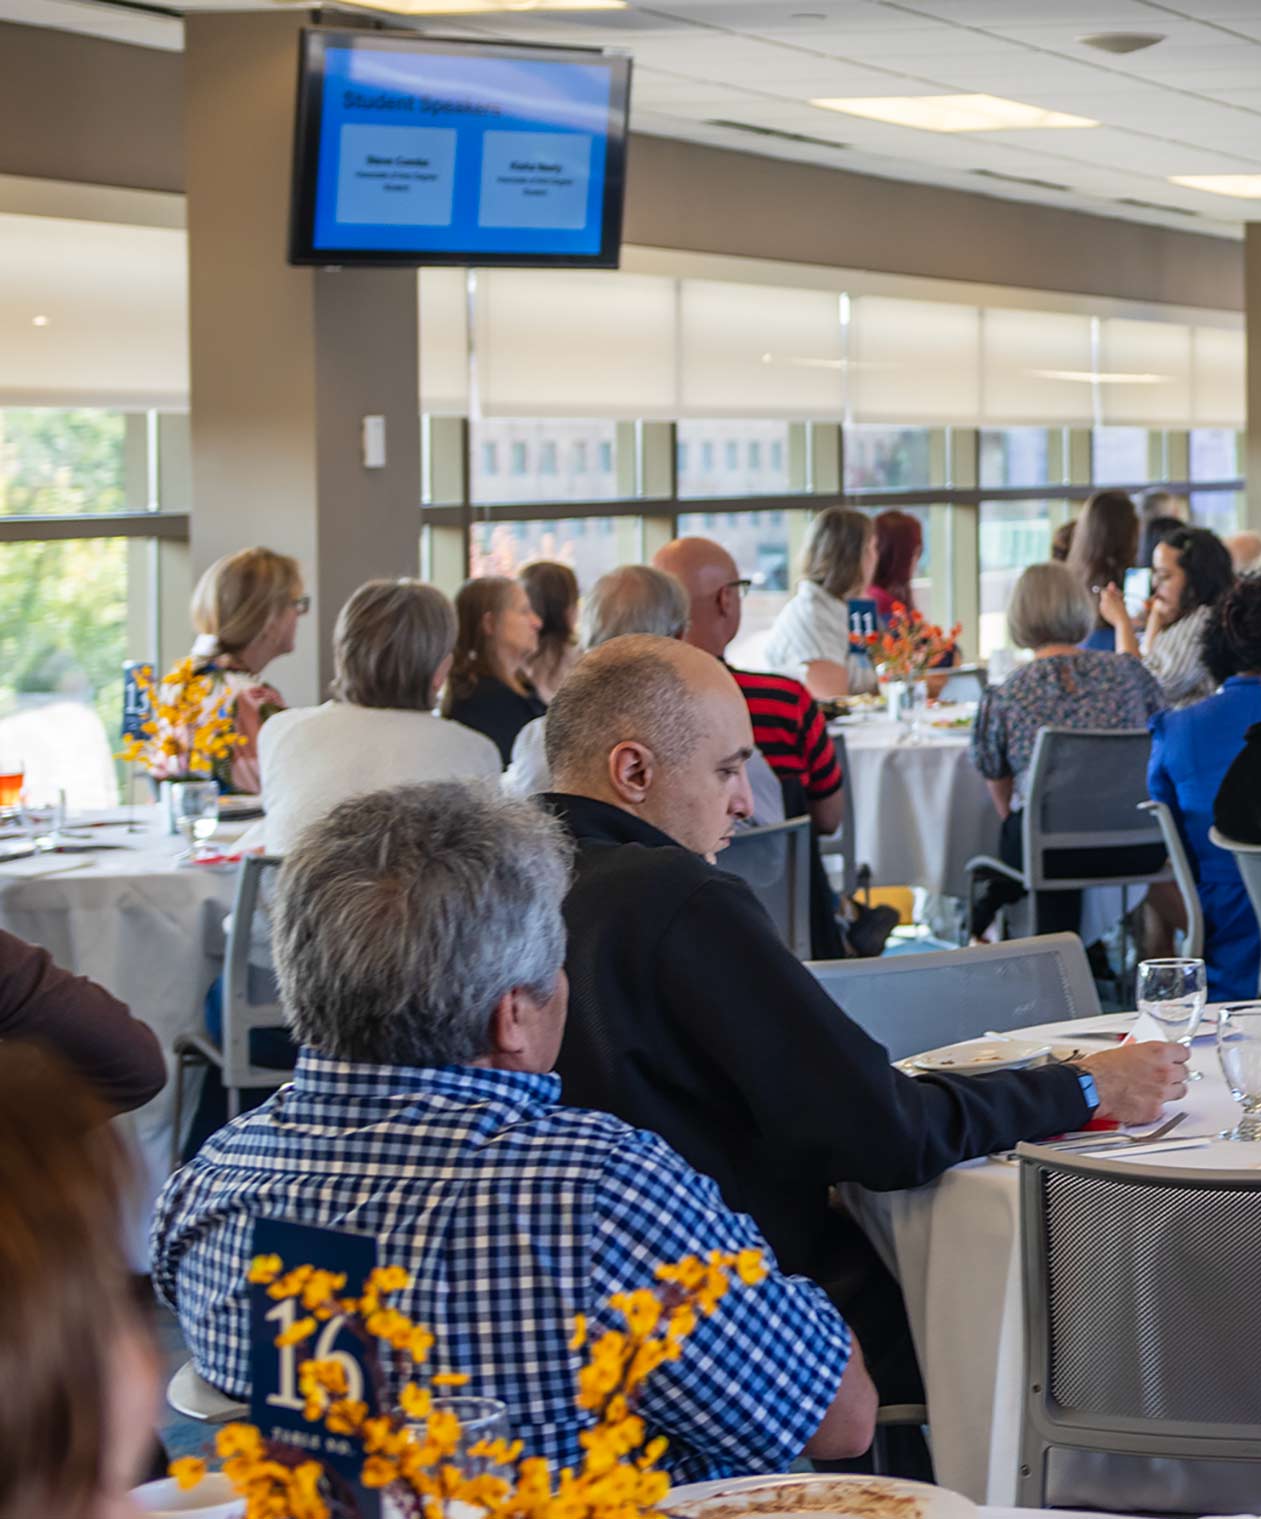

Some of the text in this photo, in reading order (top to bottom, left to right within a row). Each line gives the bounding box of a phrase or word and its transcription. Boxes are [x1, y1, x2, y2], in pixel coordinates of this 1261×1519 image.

[343, 91, 414, 111] Student
[850, 611, 873, 636] 11
[264, 1298, 364, 1410] 16
